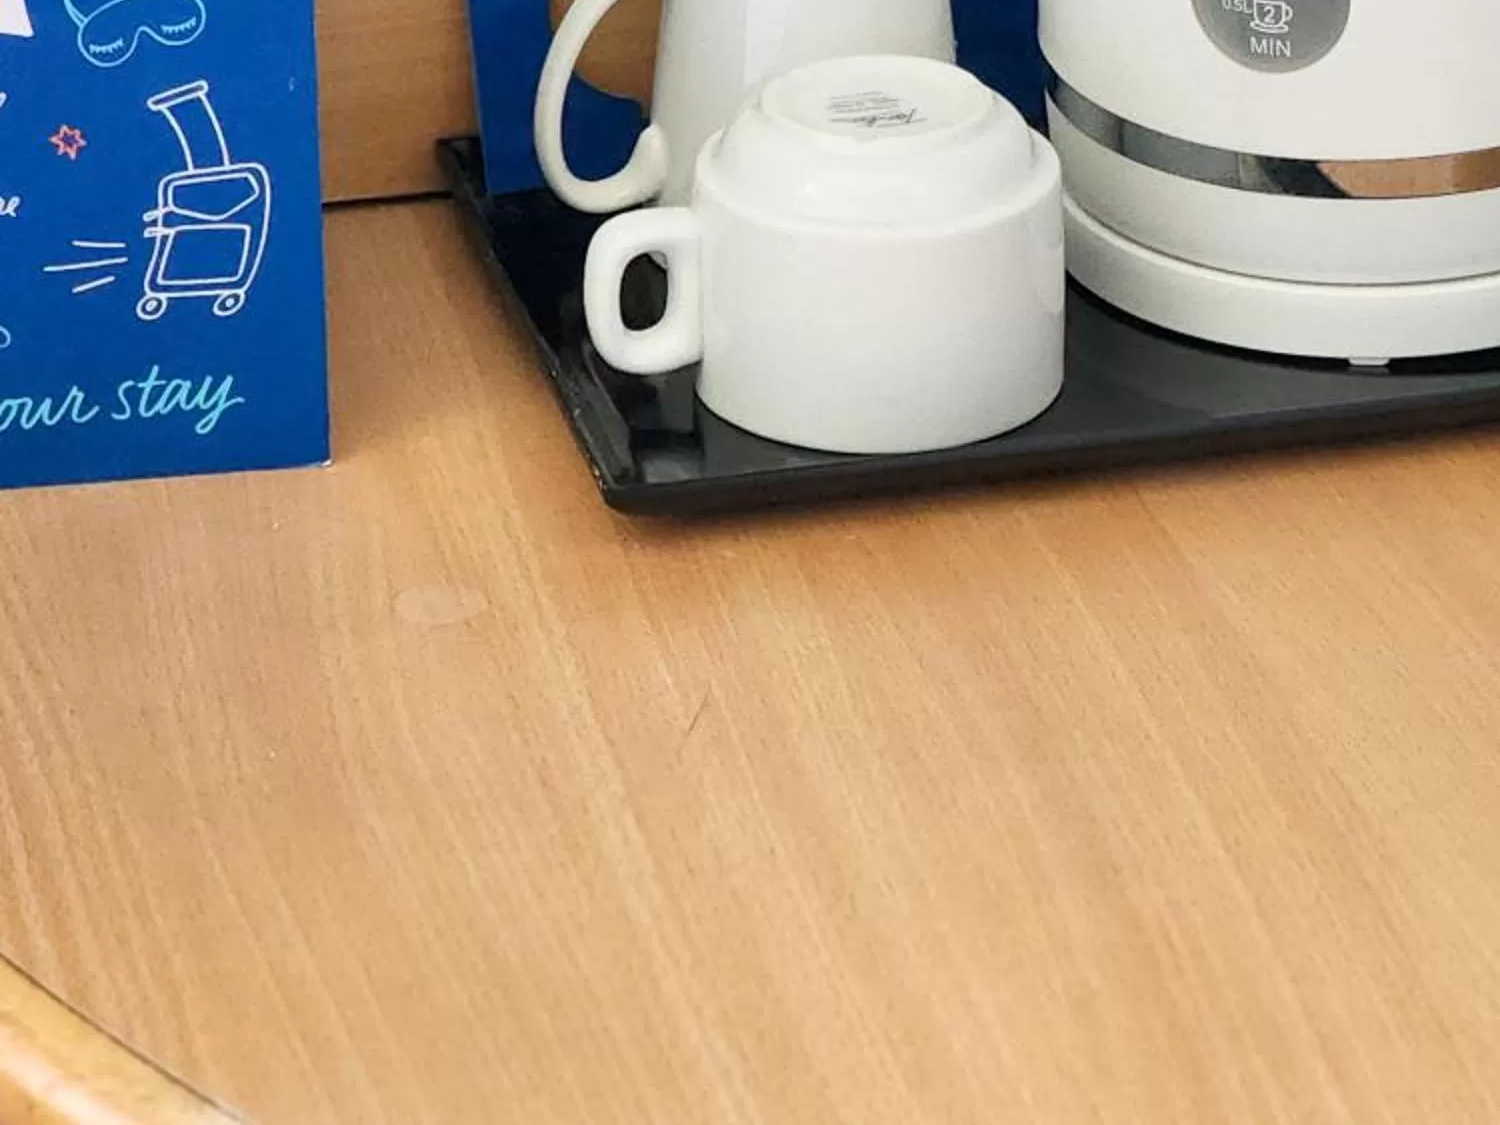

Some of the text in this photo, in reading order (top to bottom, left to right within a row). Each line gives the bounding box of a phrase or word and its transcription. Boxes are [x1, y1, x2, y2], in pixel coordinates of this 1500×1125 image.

[1263, 5, 1276, 24] 2
[1250, 36, 1291, 57] MIN
[111, 365, 244, 434] stay
